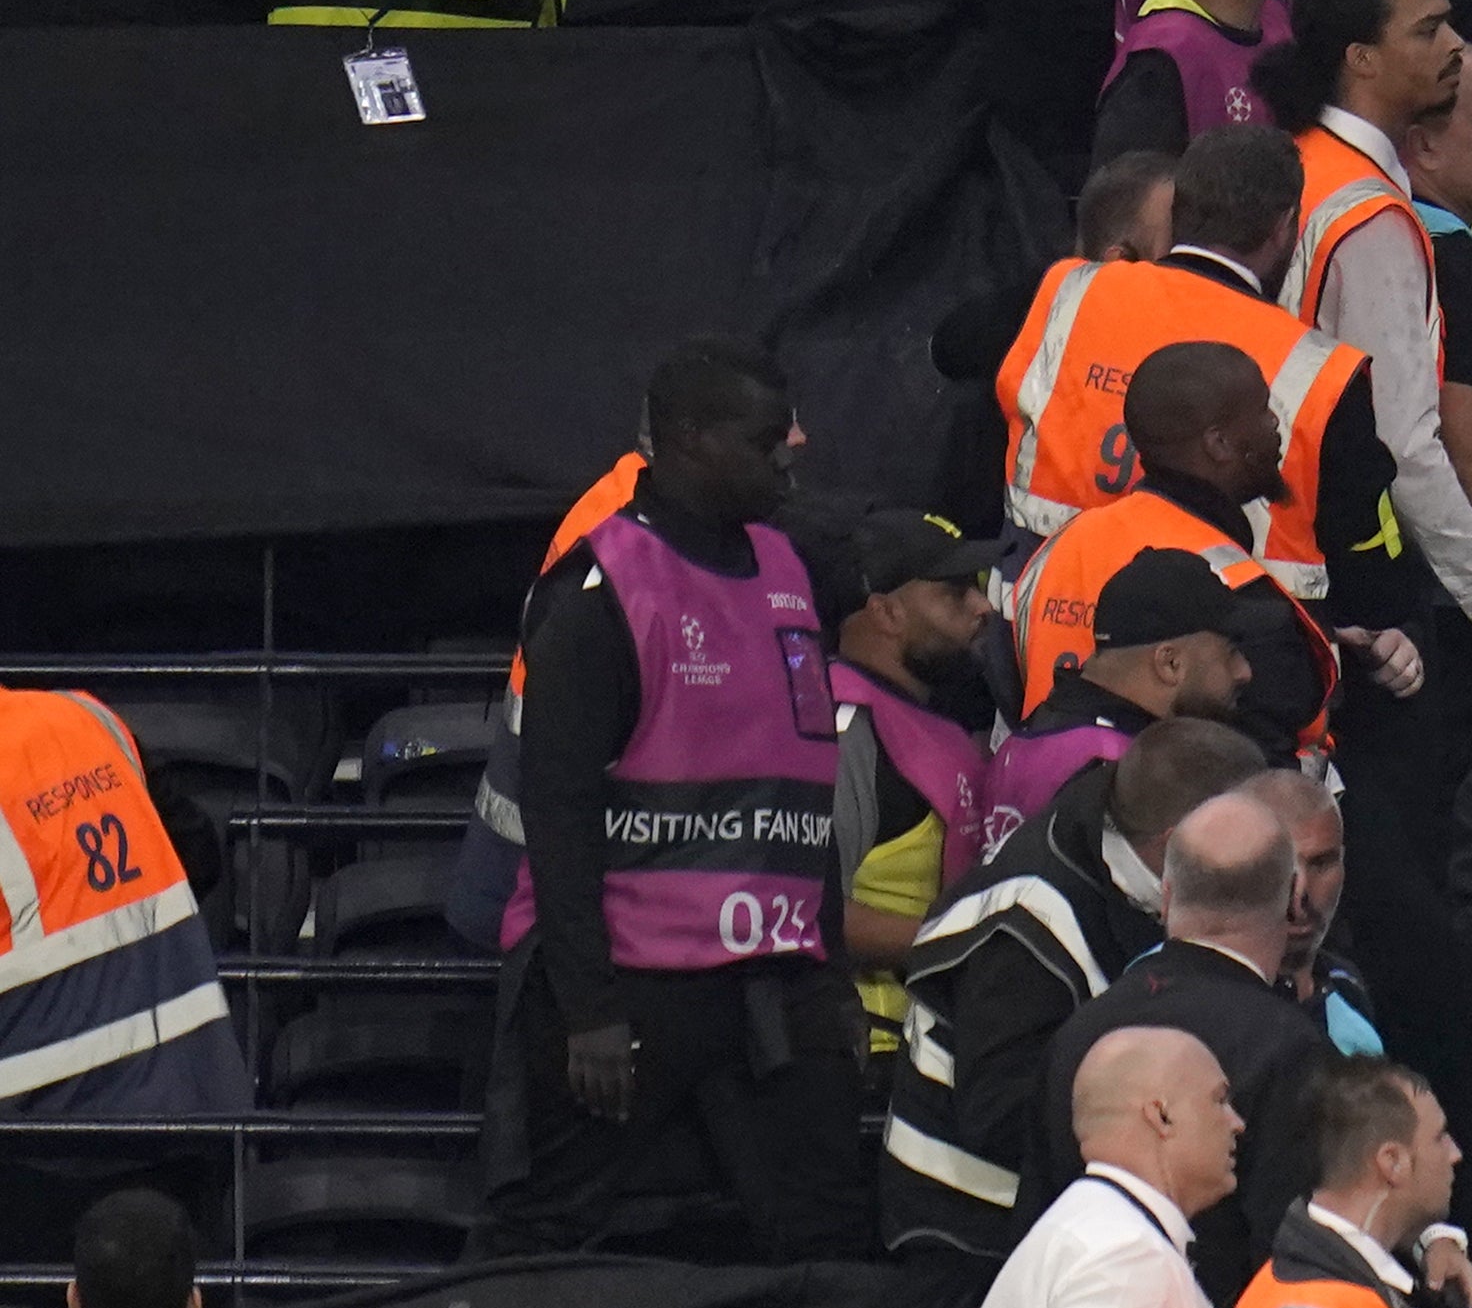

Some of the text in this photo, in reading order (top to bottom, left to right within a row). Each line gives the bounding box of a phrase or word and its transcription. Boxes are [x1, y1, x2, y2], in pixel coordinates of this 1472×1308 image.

[26, 764, 123, 829] RESPONSE
[604, 809, 743, 844] VISITING
[752, 809, 799, 841] FAN
[76, 814, 142, 892] 82
